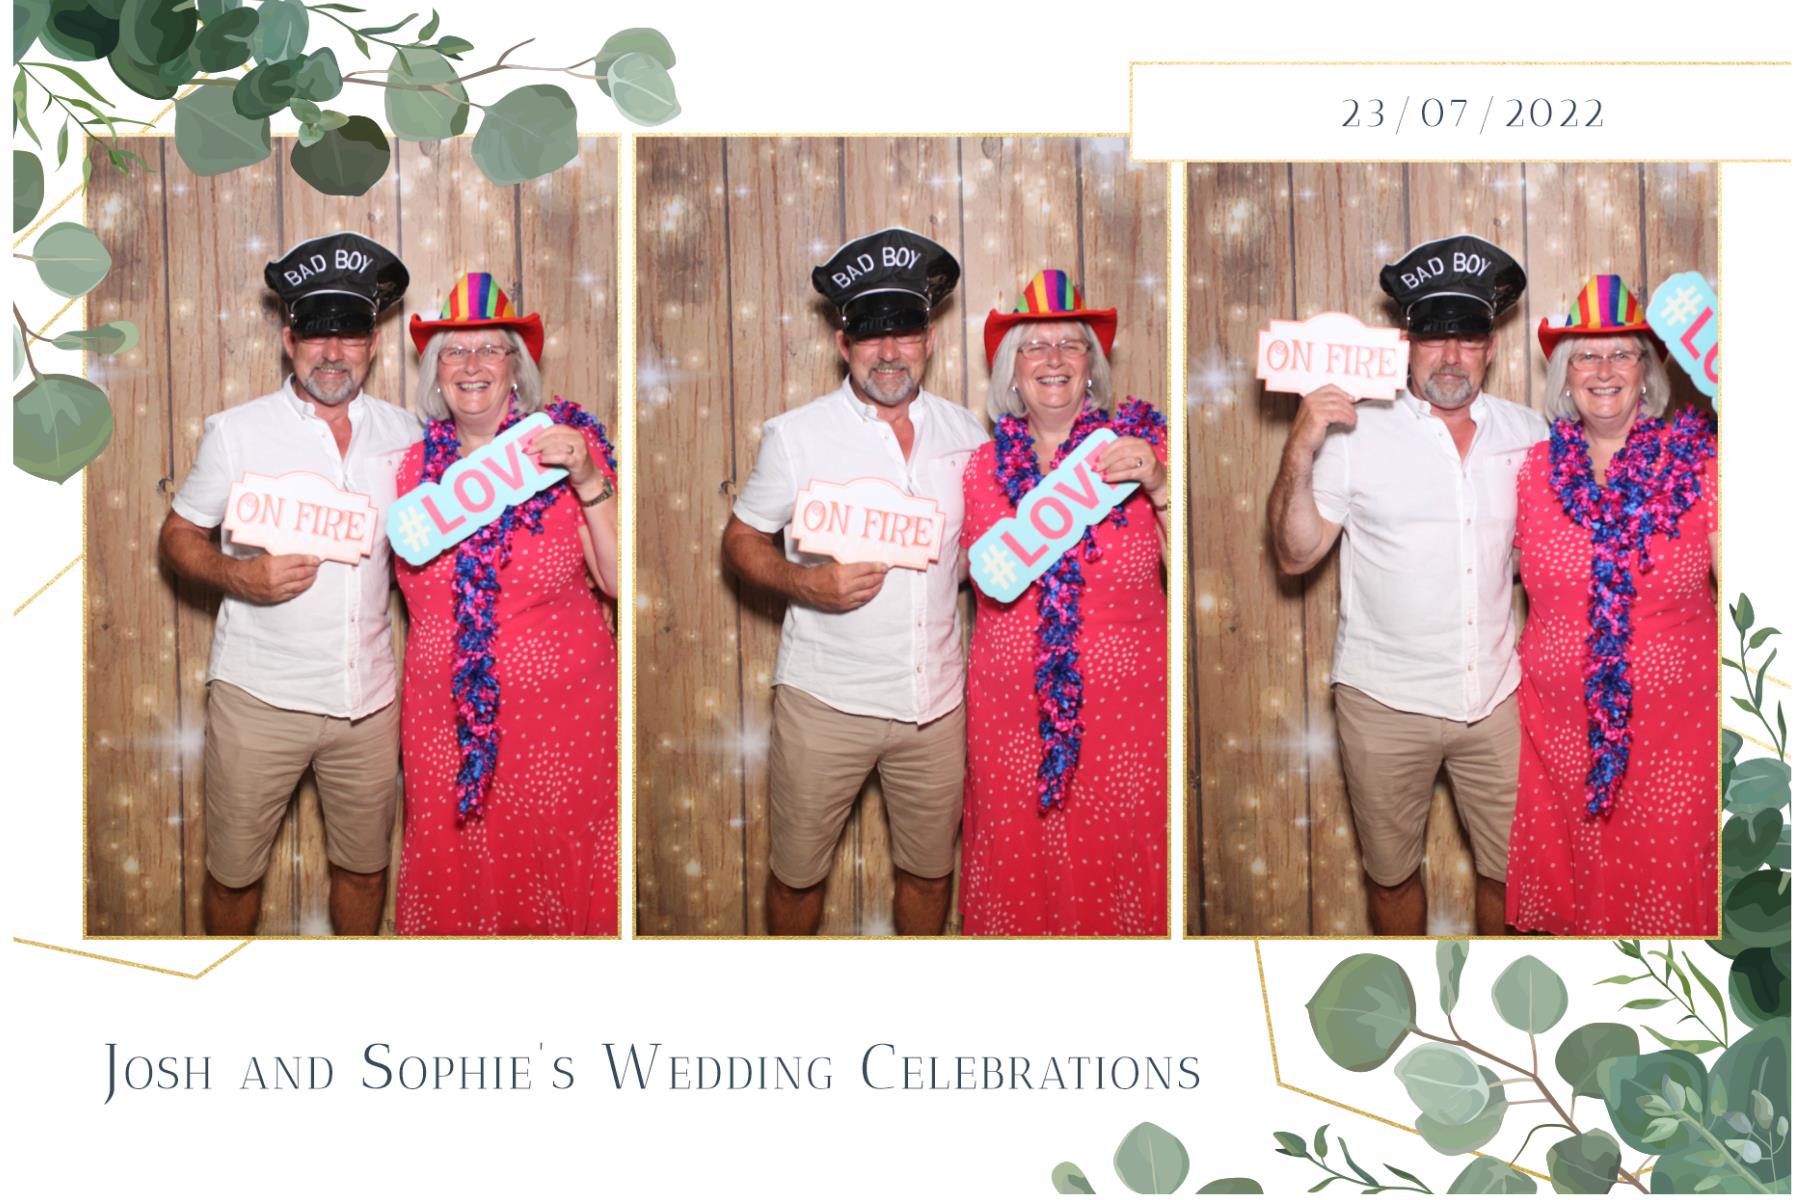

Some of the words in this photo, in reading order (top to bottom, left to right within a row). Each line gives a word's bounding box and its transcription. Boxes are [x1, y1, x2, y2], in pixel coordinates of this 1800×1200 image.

[284, 254, 327, 287] BAD
[334, 249, 374, 274] BOY
[832, 253, 874, 289] BAD
[882, 246, 922, 270] BOY
[1401, 256, 1445, 290] BAD
[1453, 252, 1492, 277] BOY
[1266, 339, 1313, 374] ON
[1325, 340, 1397, 379] FIRE
[236, 491, 282, 528] ON
[293, 499, 367, 543] FIRE
[802, 499, 855, 536] ON
[862, 506, 934, 548] FIRE
